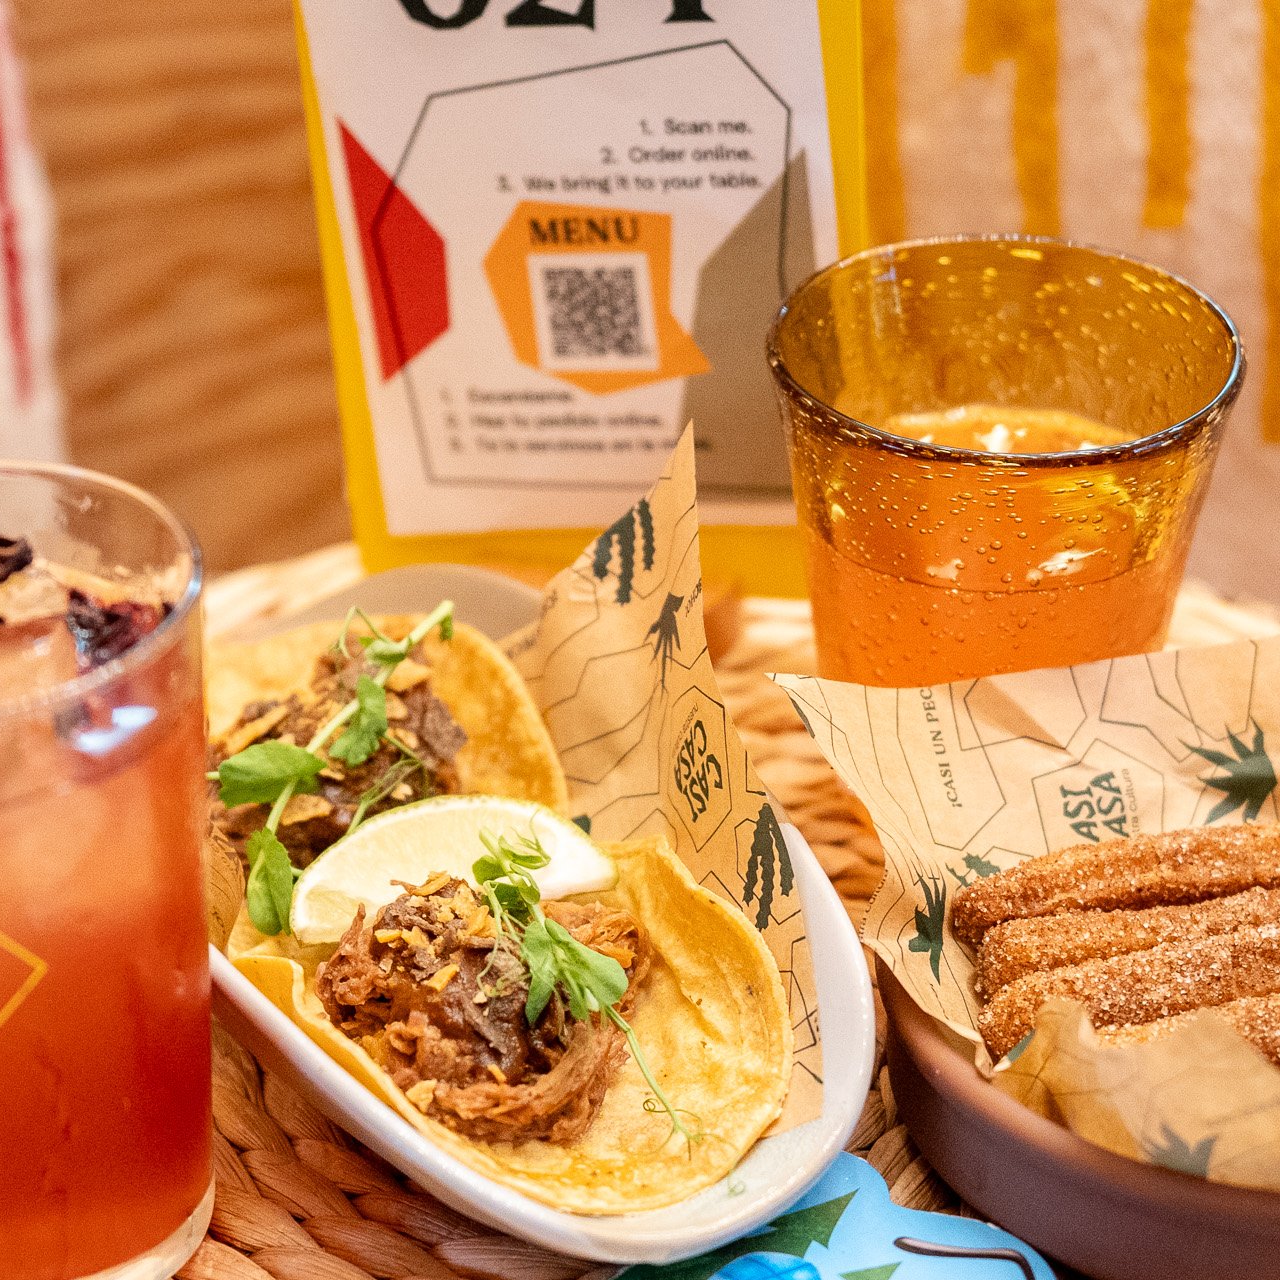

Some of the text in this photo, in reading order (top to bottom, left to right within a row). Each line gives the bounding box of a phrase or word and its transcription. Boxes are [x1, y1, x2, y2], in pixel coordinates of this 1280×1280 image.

[599, 143, 755, 165] 2. Order online.
[639, 117, 753, 137] 1. Scan me.
[523, 174, 557, 192] We
[561, 174, 612, 196] bring
[616, 173, 629, 190] it
[634, 173, 655, 190] to
[659, 175, 704, 197] your
[708, 172, 762, 191] table.
[528, 214, 640, 245] MENU
[674, 719, 707, 794] CASA
[920, 688, 962, 807] ¡CASI UN PEC
[689, 754, 723, 823] CASI
[1059, 784, 1100, 843] ASI
[1090, 771, 1130, 838] ASA
